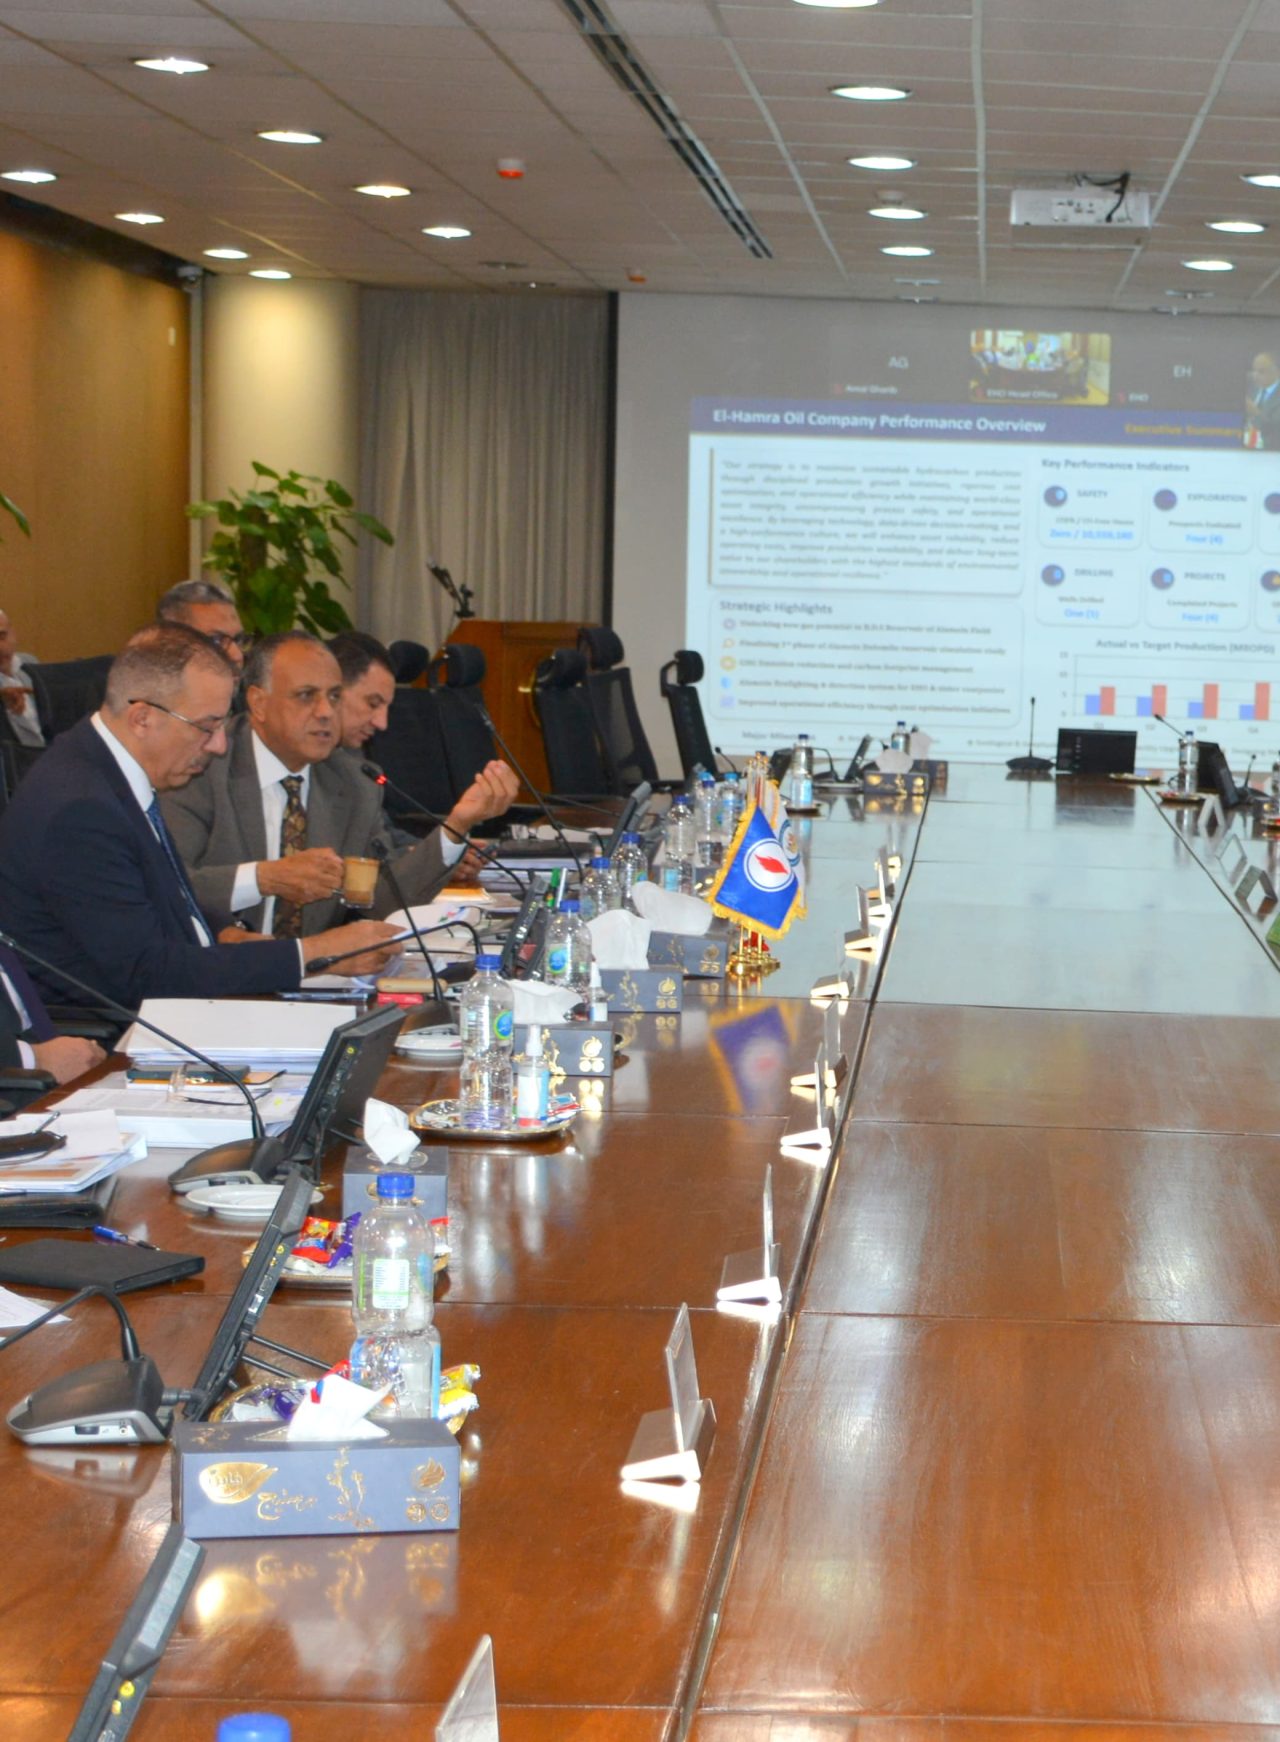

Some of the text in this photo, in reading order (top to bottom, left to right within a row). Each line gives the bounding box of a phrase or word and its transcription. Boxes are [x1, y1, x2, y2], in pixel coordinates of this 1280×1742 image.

[888, 357, 908, 369] AG
[1173, 366, 1192, 378] EH
[714, 410, 1045, 432] El-Hamra Oil Company Performance Overview
[1124, 423, 1182, 435] Executive
[1041, 459, 1189, 471] Key Performance Indicators
[1077, 489, 1108, 498] SAFETY
[1187, 493, 1247, 502] EXPLORATION
[720, 602, 832, 615] Strategic Highlights
[1097, 640, 1127, 648] Actual
[1143, 641, 1171, 652] Target
[1174, 642, 1226, 651] Production
